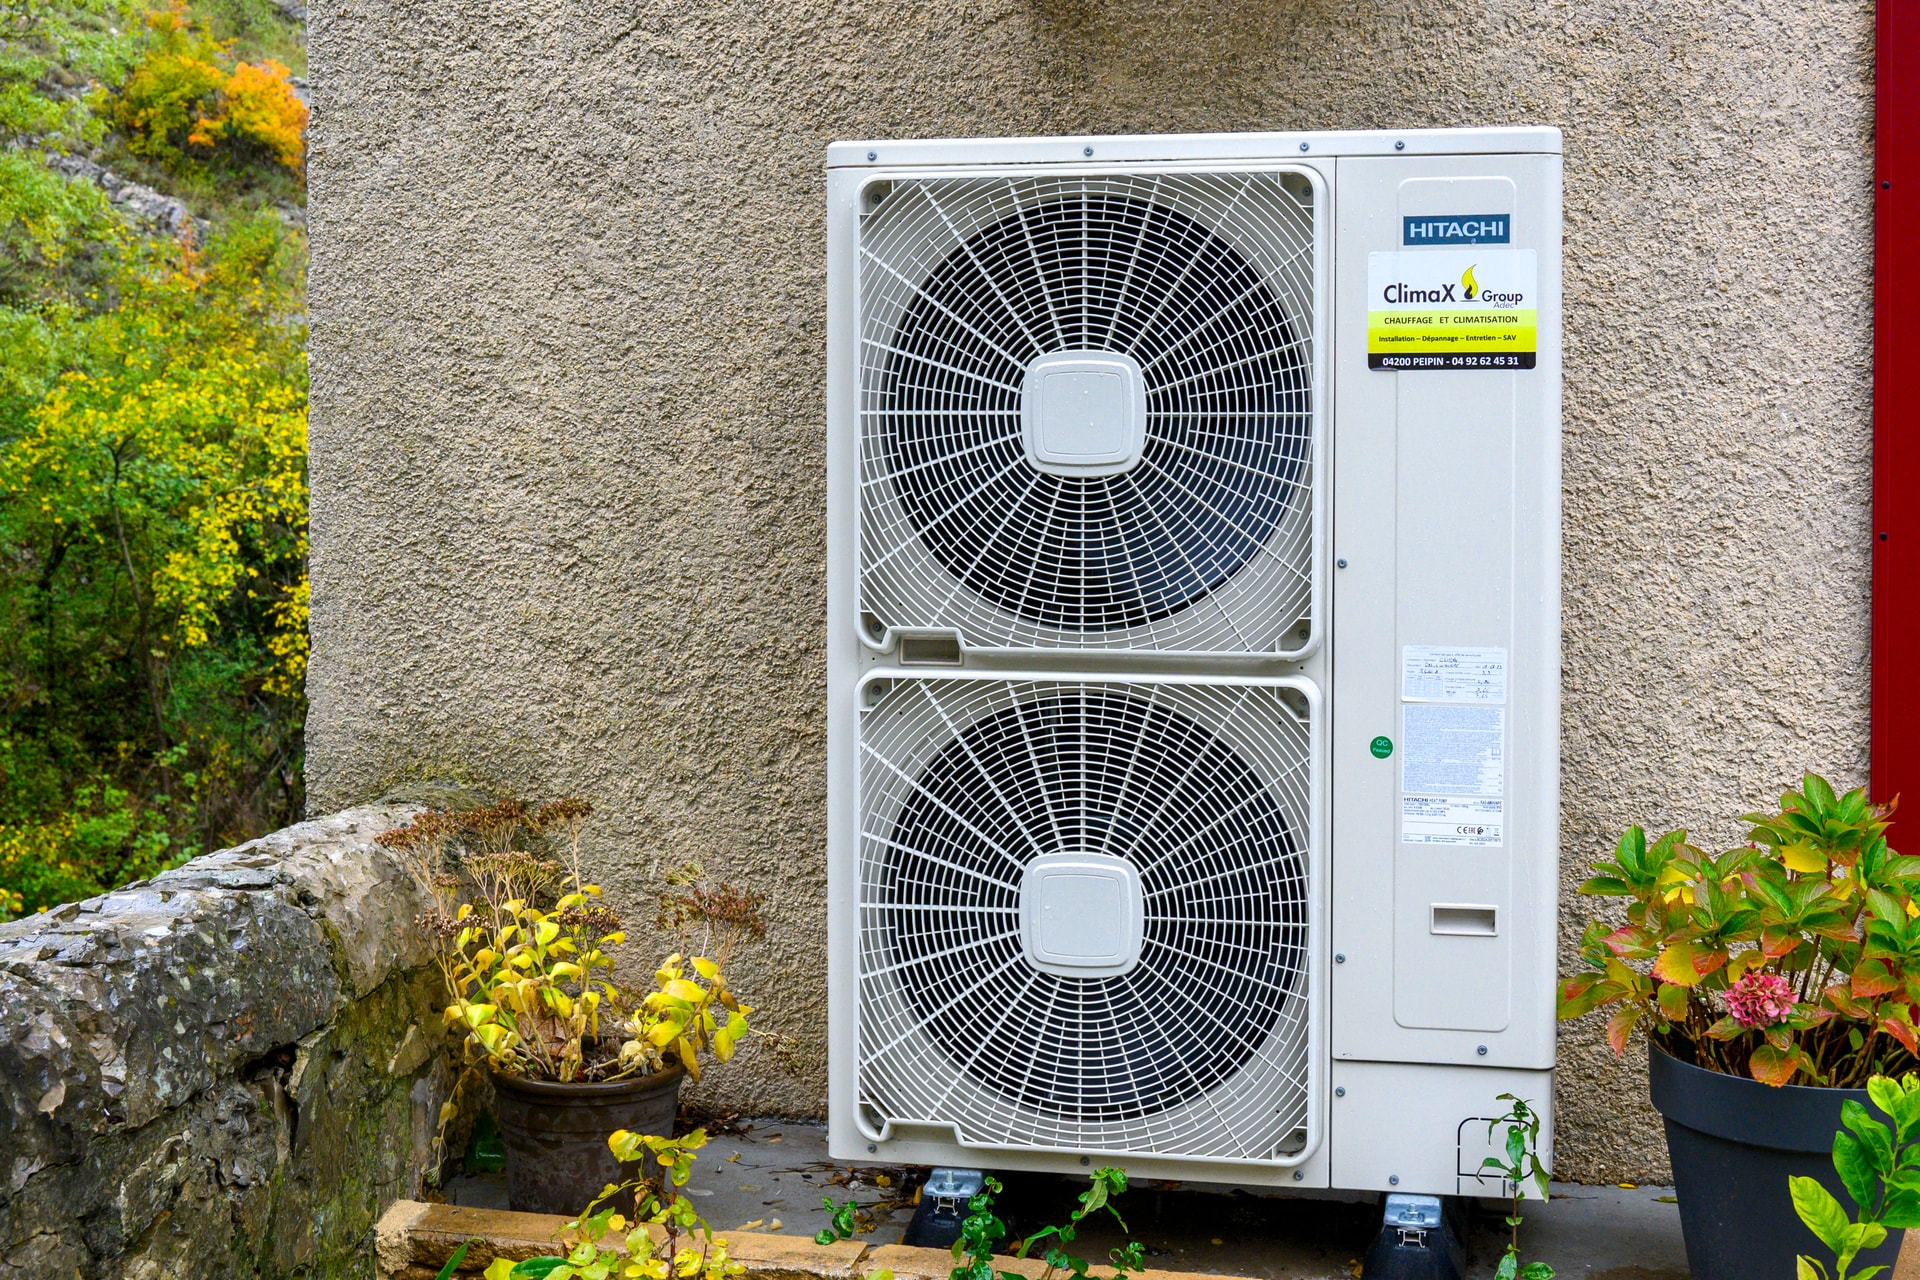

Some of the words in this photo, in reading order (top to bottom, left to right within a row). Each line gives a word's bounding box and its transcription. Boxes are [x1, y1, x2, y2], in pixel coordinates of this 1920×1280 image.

[1410, 221, 1503, 238] HITACHI
[1383, 283, 1456, 303] ClimaX
[1482, 290, 1523, 305] Group
[1384, 317, 1433, 325] CHAUFFAGE
[1453, 316, 1518, 324] CLIMATISATION
[1382, 357, 1411, 367] 04200
[1413, 357, 1444, 366] PEIPIN
[1452, 357, 1463, 366] 04
[1465, 357, 1477, 366] 92
[1480, 357, 1492, 366] 62
[1493, 357, 1505, 366] 45
[1507, 357, 1519, 366] 31
[1376, 739, 1389, 747] QC
